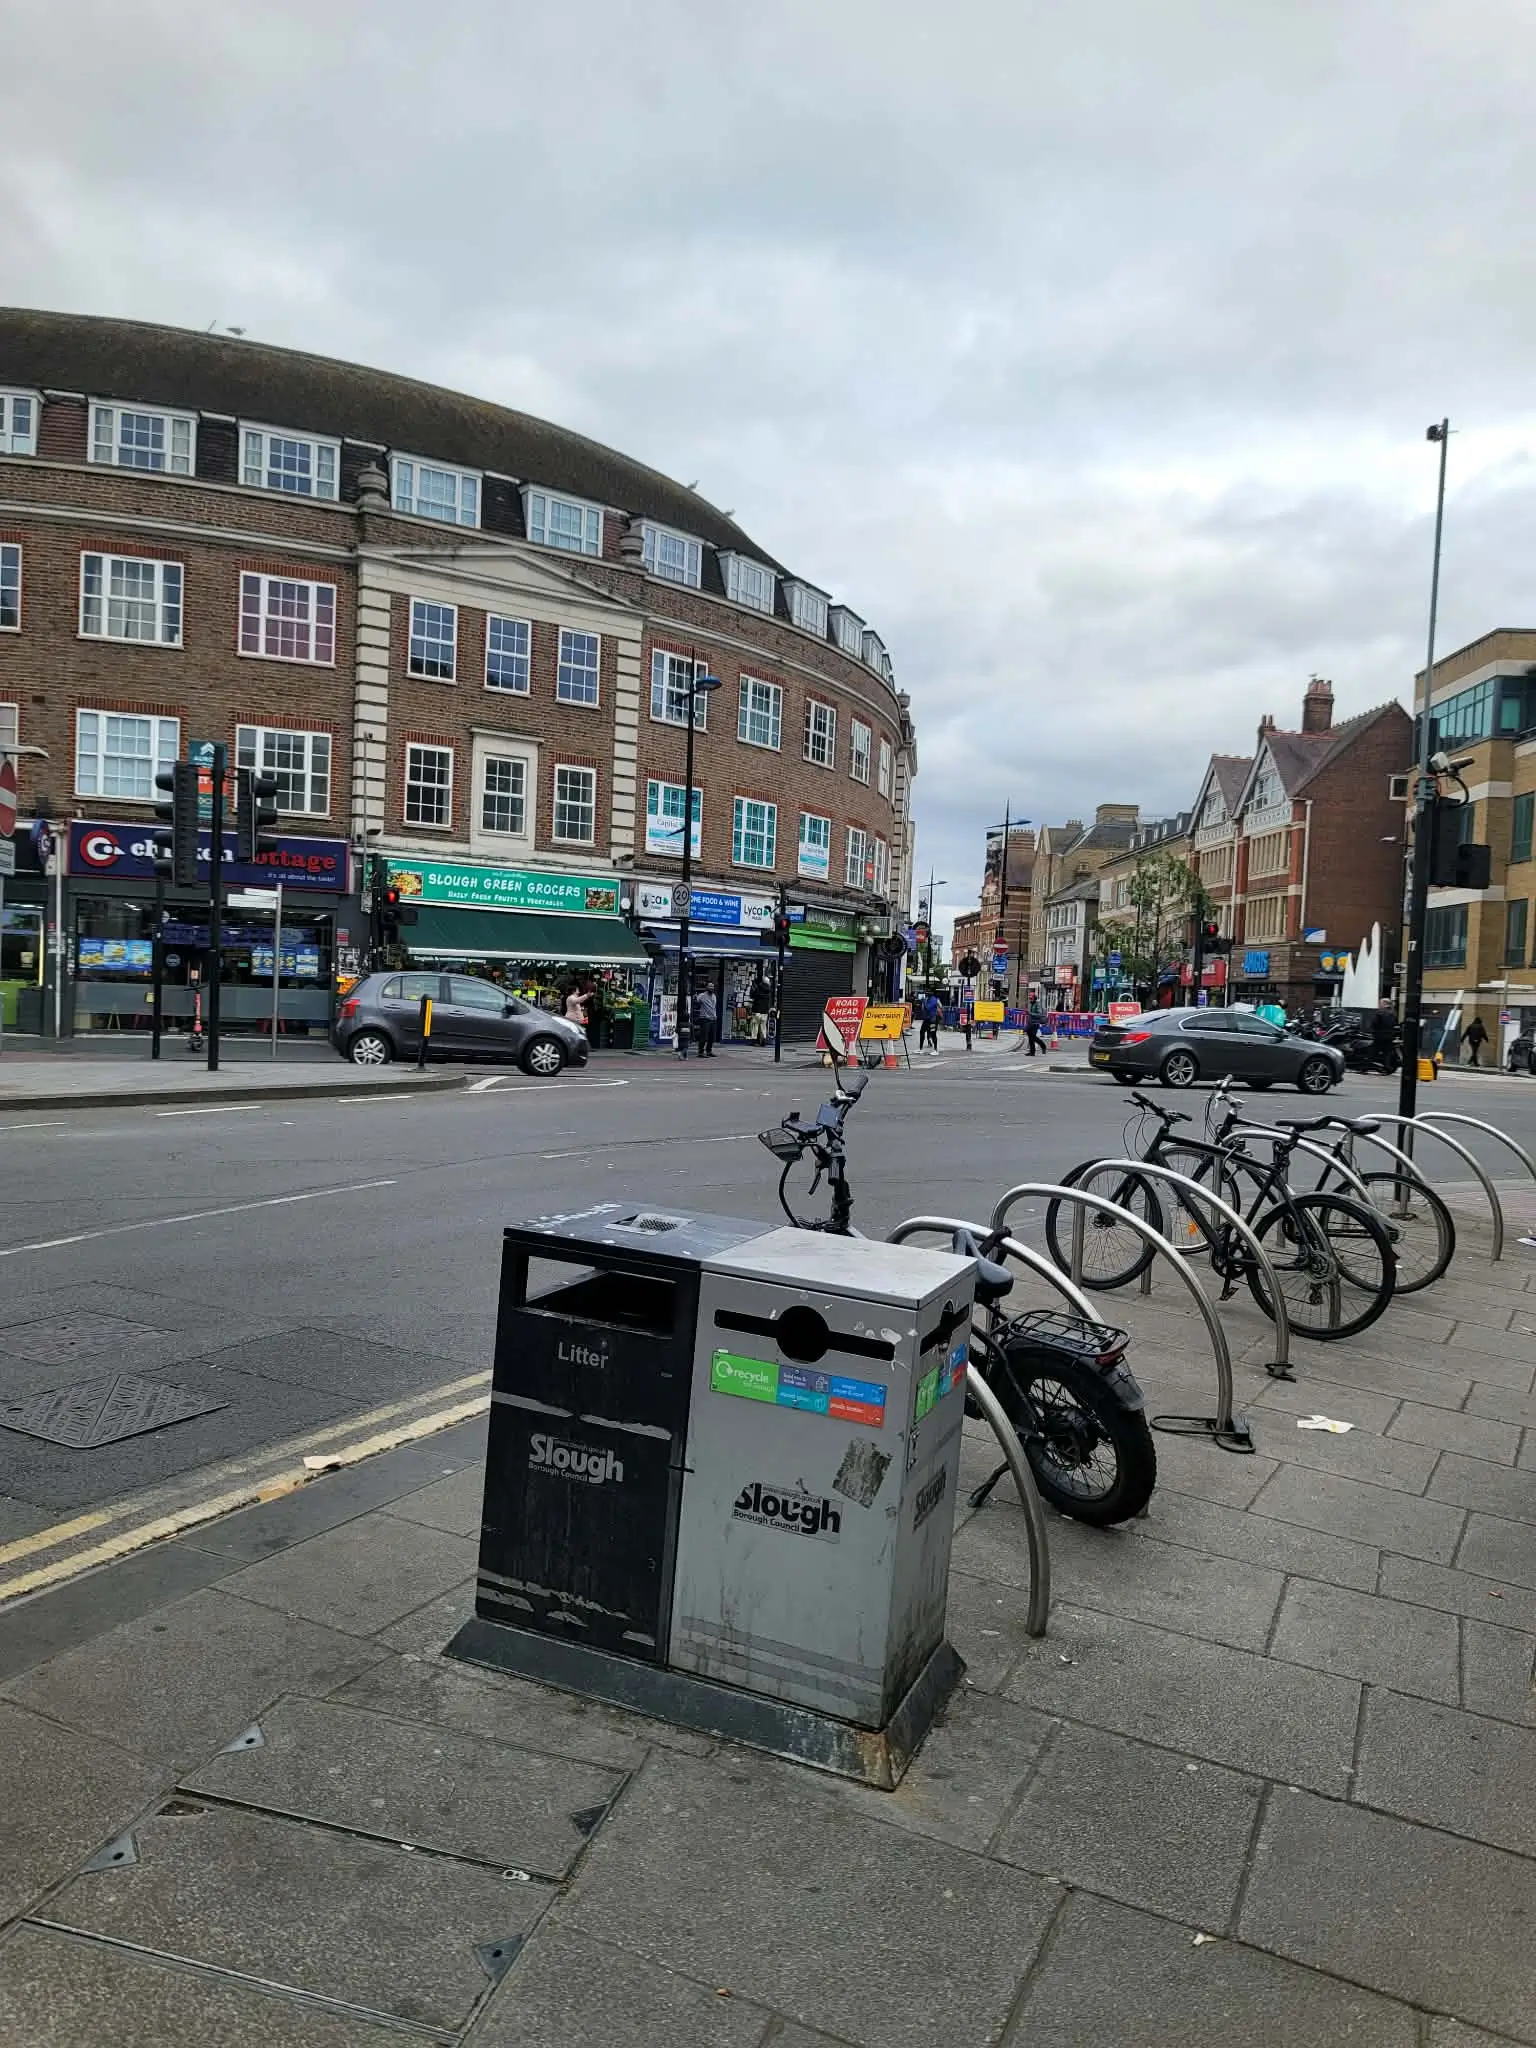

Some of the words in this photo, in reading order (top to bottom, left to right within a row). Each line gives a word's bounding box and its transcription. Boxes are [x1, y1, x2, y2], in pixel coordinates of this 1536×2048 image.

[253, 849, 337, 873] ottage
[428, 873, 478, 888] SLOUGH
[483, 877, 523, 892] GREEN
[527, 882, 581, 897] GROCERS
[702, 896, 718, 905] FOOD
[724, 899, 739, 908] WINE
[830, 1008, 859, 1016] AHEAD
[836, 999, 859, 1007] ROAD
[865, 1011, 901, 1019] Diversion
[558, 1341, 609, 1369] Litter
[734, 1368, 769, 1387] recycle
[529, 1433, 624, 1484] Slough
[528, 1461, 560, 1477] Borough
[560, 1469, 588, 1482] Council
[734, 1482, 841, 1535] Slough
[733, 1508, 768, 1525] Borough
[769, 1518, 800, 1533] Council
